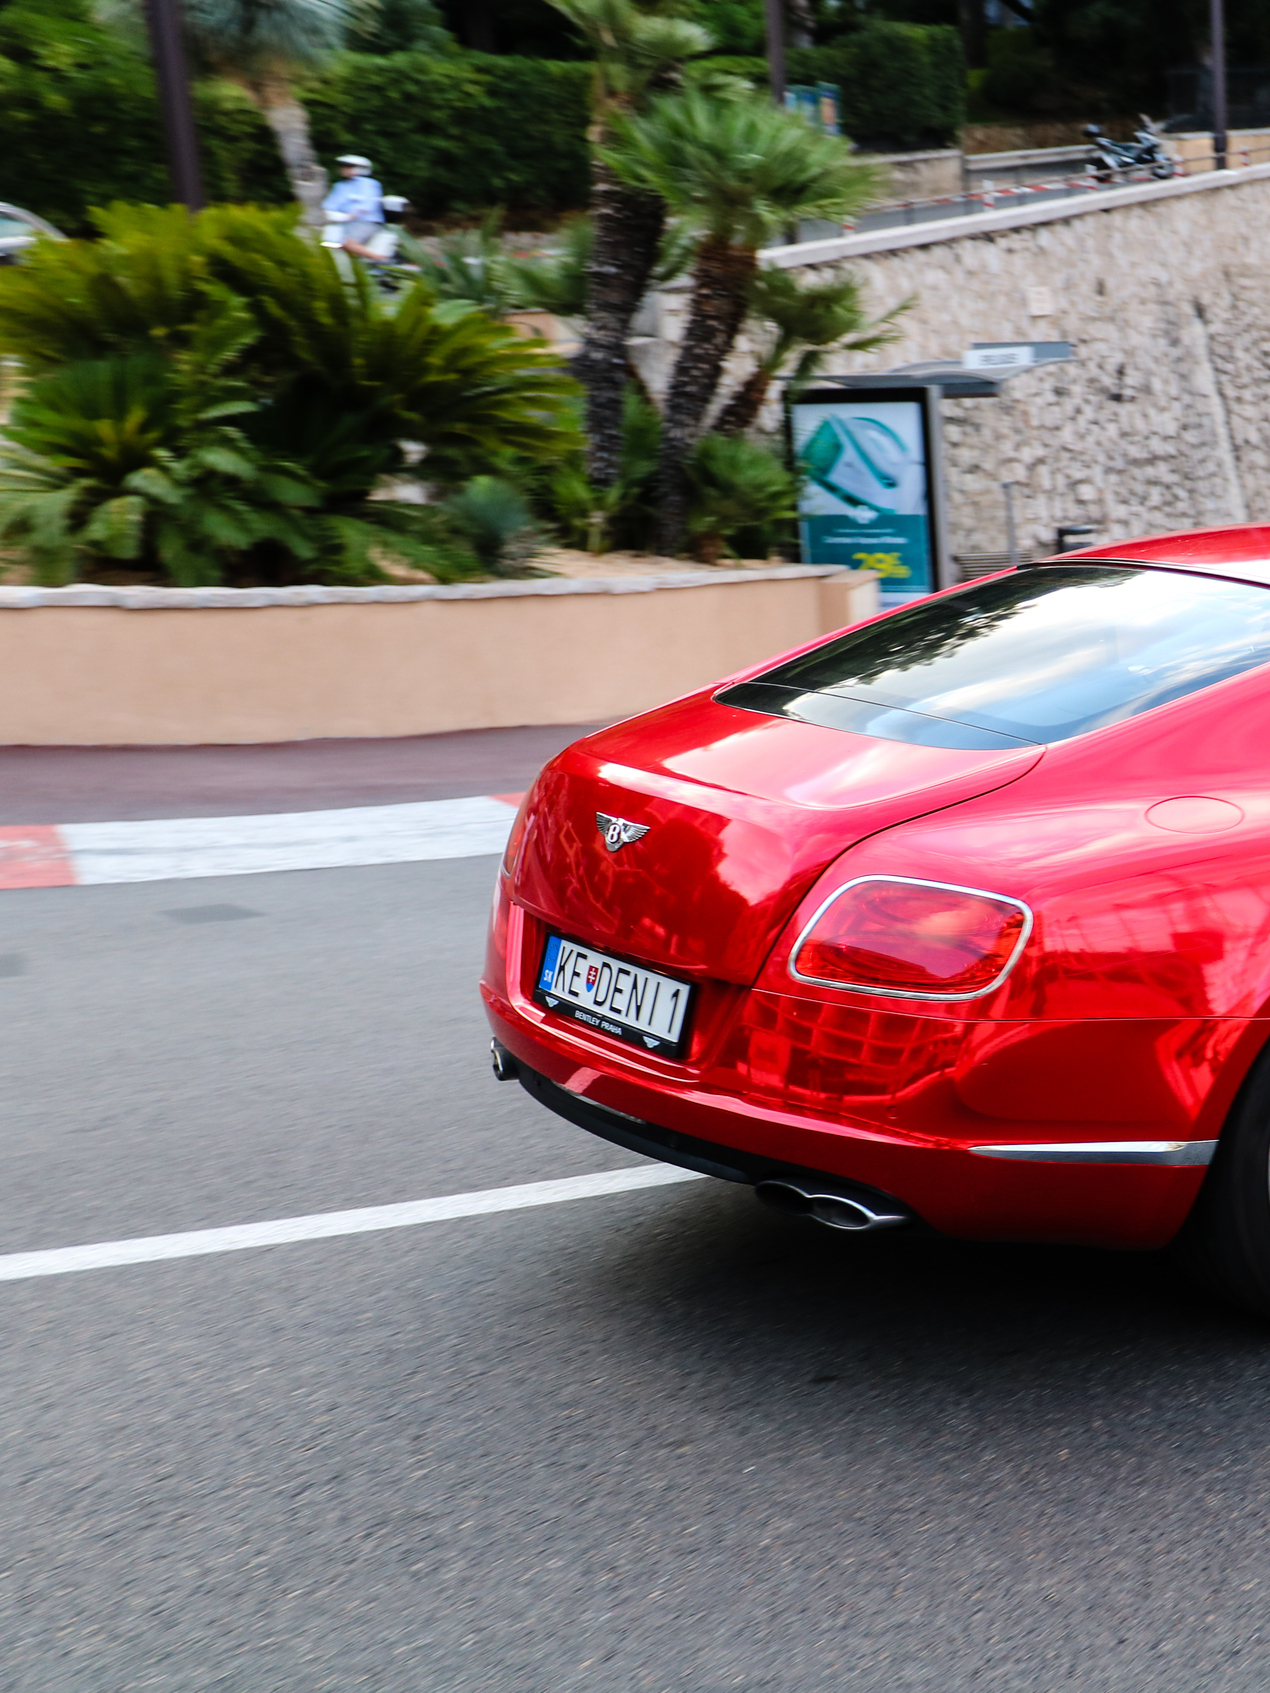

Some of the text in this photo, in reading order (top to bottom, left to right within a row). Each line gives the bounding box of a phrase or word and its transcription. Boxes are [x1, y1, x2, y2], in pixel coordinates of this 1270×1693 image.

[543, 969, 553, 983] SK
[555, 946, 588, 997] KE
[574, 1010, 622, 1036] BENTLEY PRAHA
